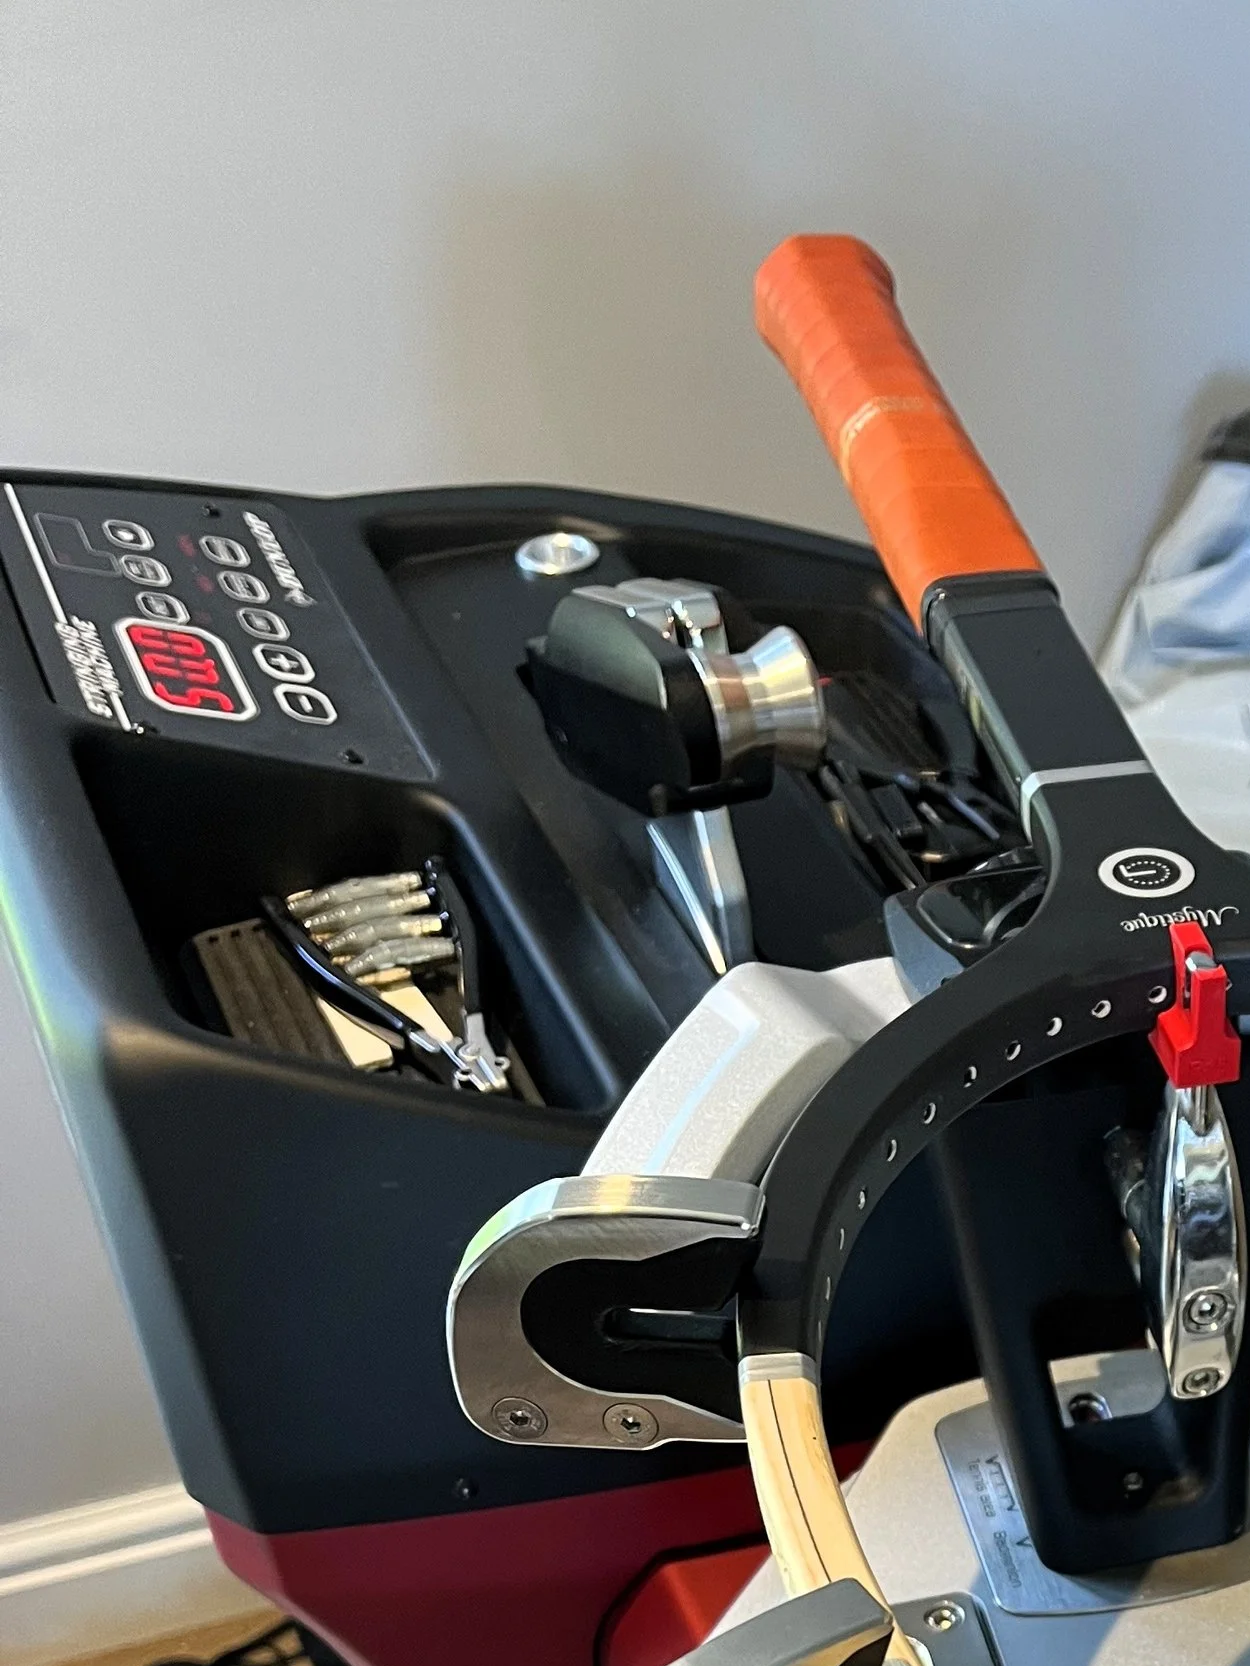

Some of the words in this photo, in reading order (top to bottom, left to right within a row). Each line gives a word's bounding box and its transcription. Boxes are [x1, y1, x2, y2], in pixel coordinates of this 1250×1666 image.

[242, 511, 304, 591] DUNLOP
[54, 621, 113, 719] STRINGING
[70, 615, 124, 696] MACHINE
